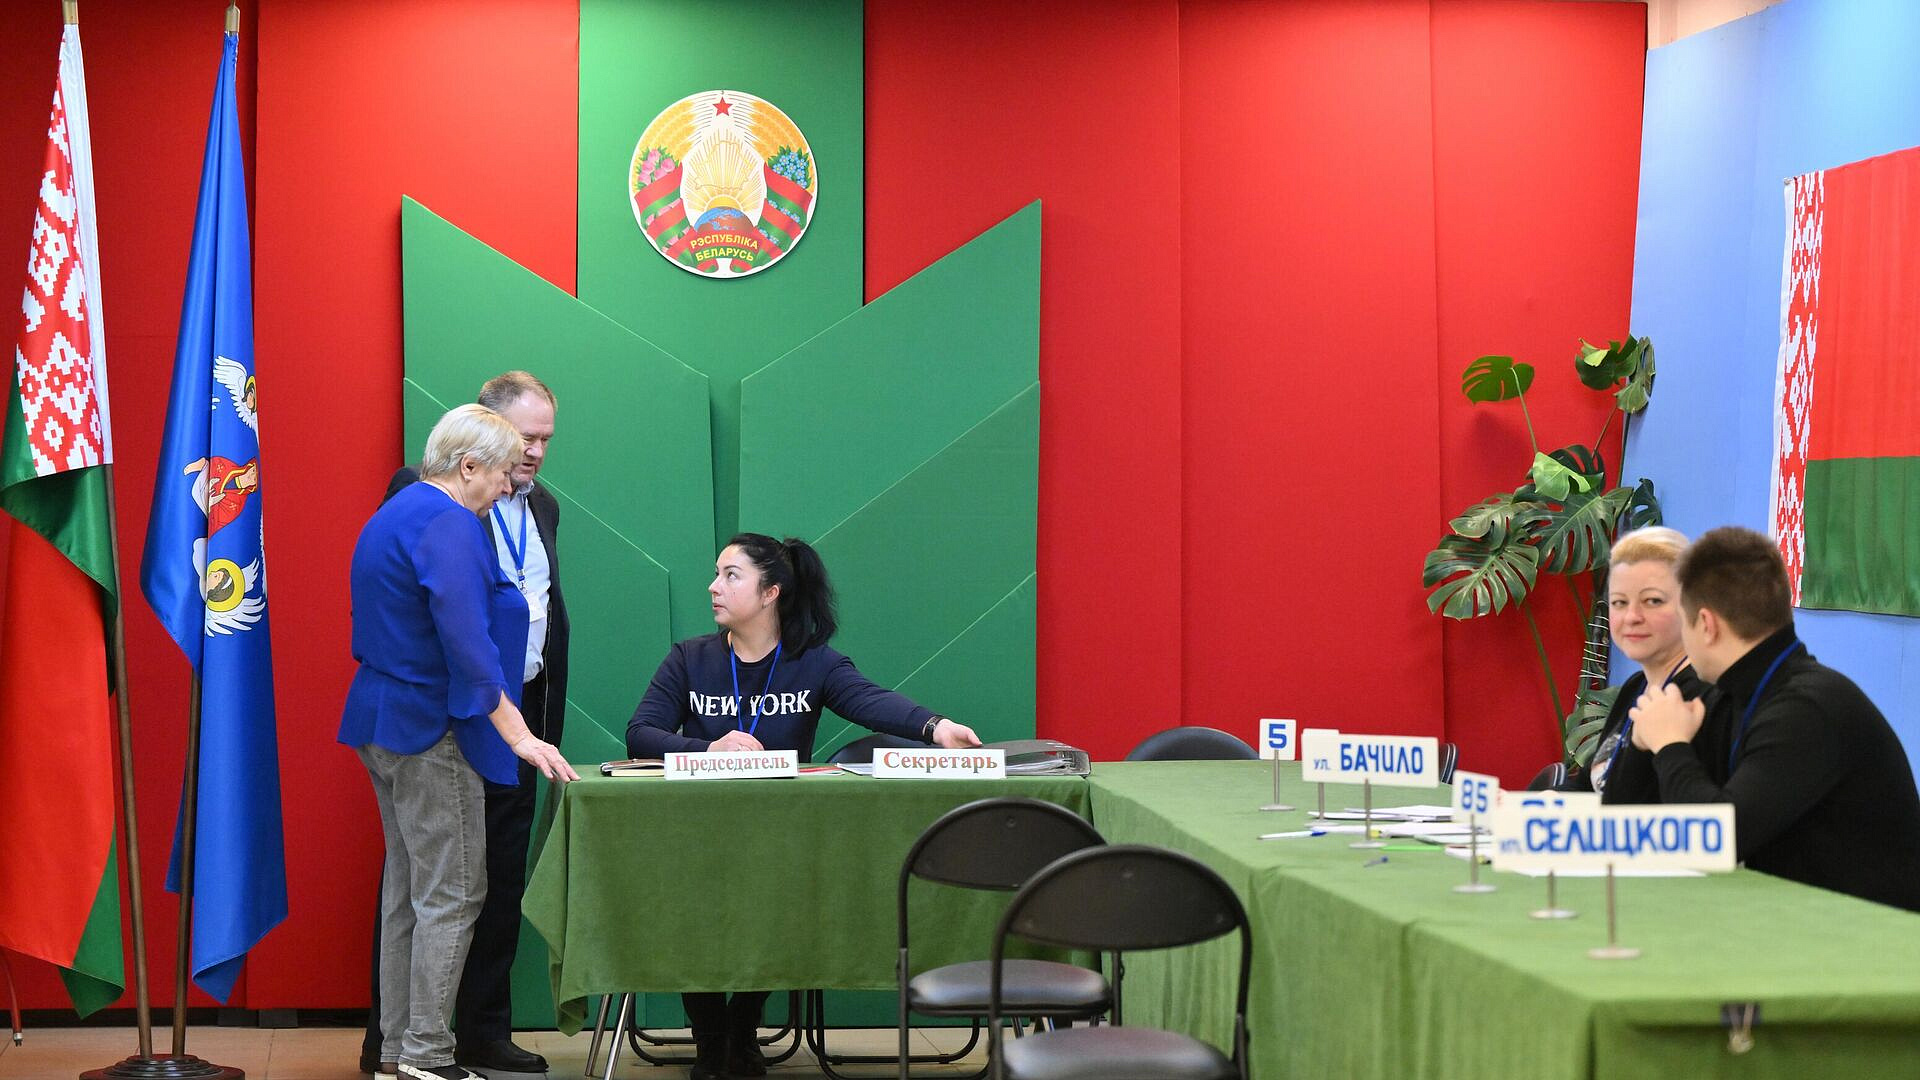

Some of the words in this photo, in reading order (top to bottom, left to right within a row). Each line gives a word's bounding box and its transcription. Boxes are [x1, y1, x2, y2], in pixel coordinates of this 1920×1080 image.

[690, 234, 758, 249] РЭСПУБЛІКА
[695, 247, 754, 261] БЕЛАРУСЬ
[689, 690, 742, 717] NEW
[749, 689, 812, 716] YORK
[1268, 723, 1287, 749] 5
[674, 755, 790, 776] Председатель
[883, 751, 998, 773] Секретарь
[1340, 743, 1424, 774] БАЧИЛО
[1461, 778, 1488, 813] 85
[1526, 817, 1722, 857] СЕЛИЦКОГО
